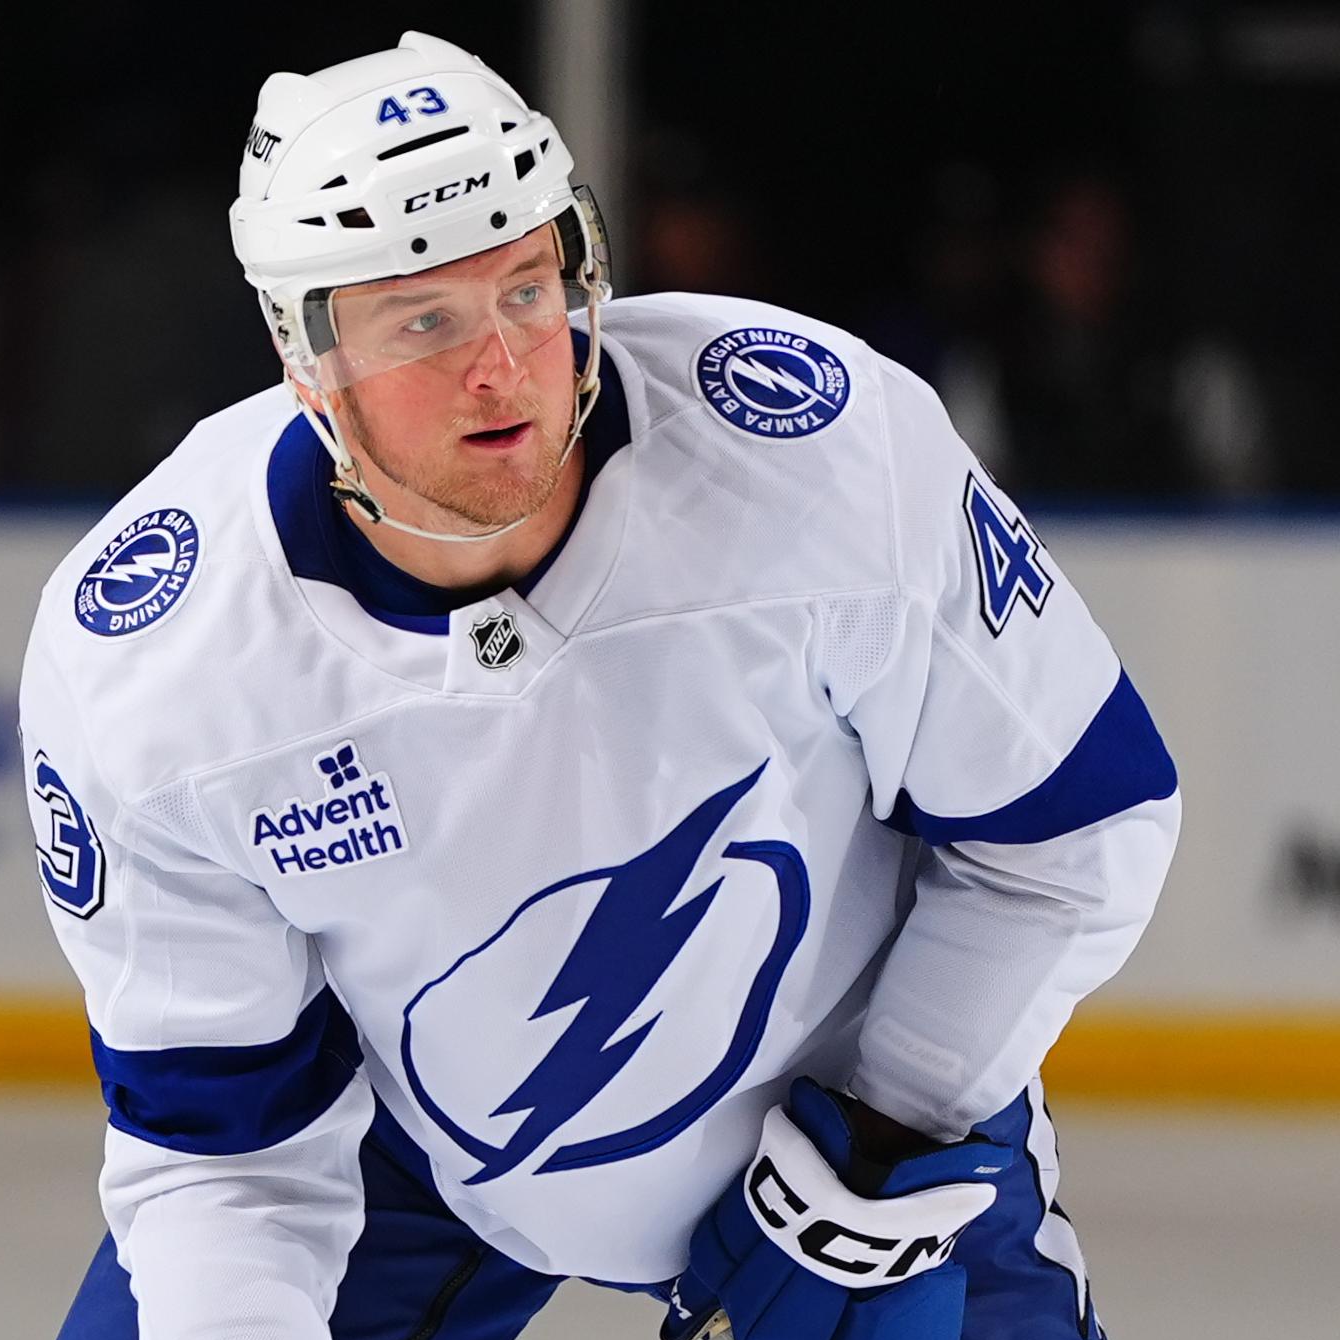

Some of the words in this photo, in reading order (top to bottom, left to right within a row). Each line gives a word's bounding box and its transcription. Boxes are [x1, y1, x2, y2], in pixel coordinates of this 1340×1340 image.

[376, 86, 450, 126] 43
[403, 171, 492, 214] CCM
[703, 330, 809, 372] LIGHTNING
[704, 379, 741, 414] BAY
[744, 410, 825, 433] TAMPA
[97, 512, 161, 562] TAMPA
[162, 511, 192, 535] BAY
[962, 469, 1055, 639] 4
[109, 537, 195, 631] LIGHTNING
[485, 624, 512, 663] NHL
[33, 749, 107, 921] 3
[253, 780, 391, 846] Advent
[270, 821, 403, 875] Health
[748, 1154, 960, 1278] CCM
